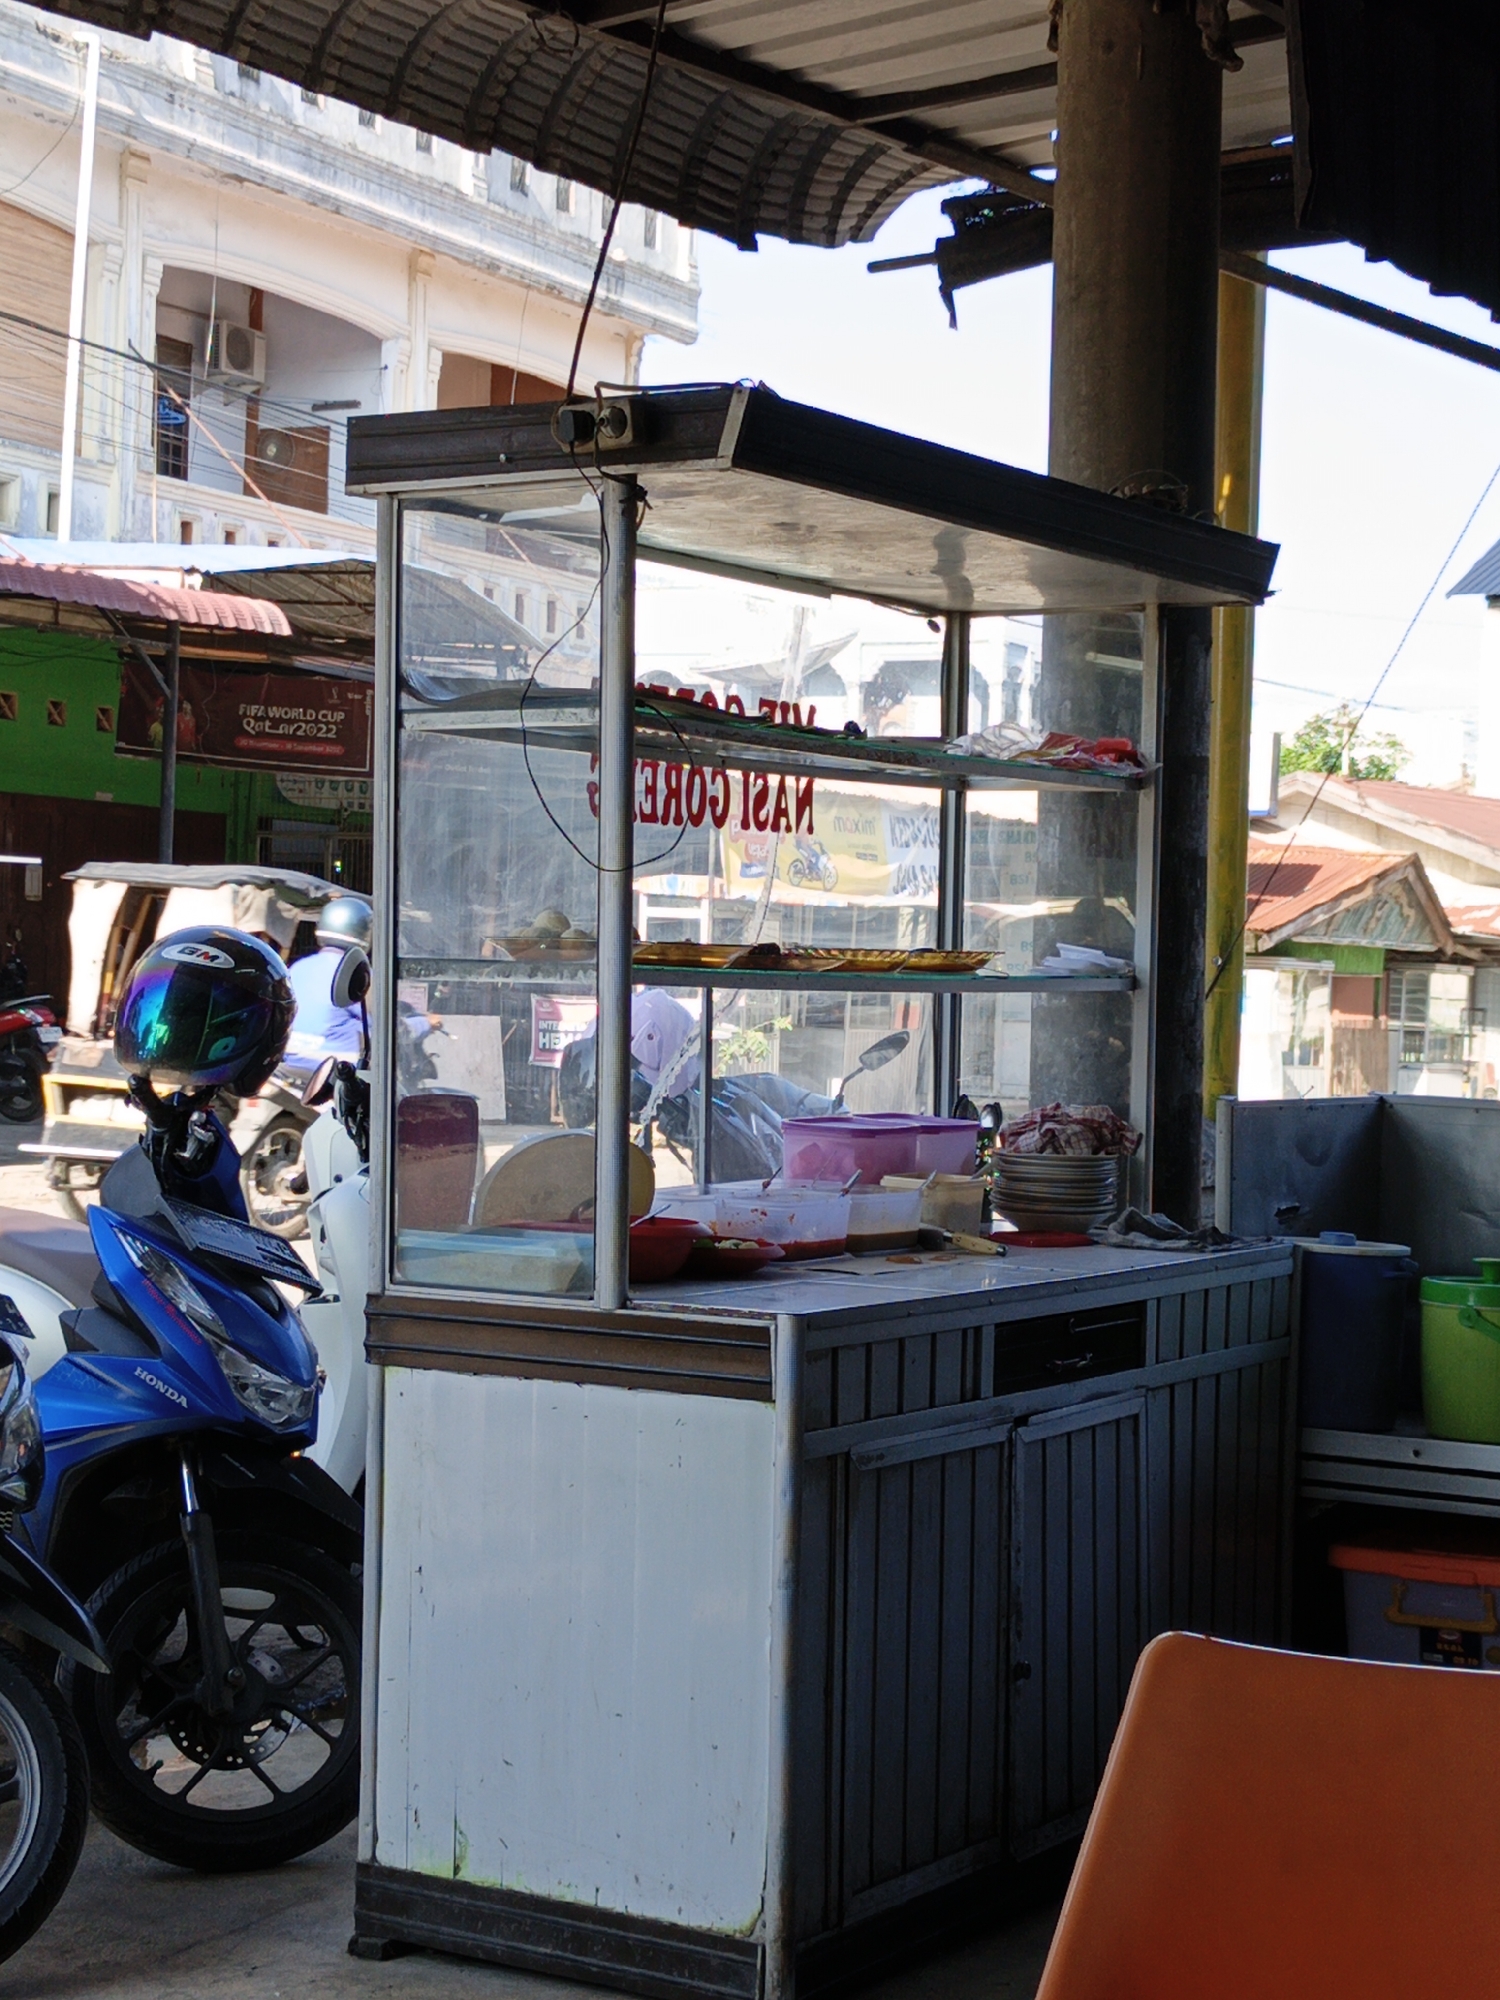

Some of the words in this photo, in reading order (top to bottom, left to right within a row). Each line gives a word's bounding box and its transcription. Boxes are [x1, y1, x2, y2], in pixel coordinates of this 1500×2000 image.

[239, 704, 266, 717] FIFA
[268, 706, 316, 720] WORLD
[318, 710, 345, 722] CUP
[176, 946, 220, 963] GM
[133, 1366, 189, 1409] HONDA
